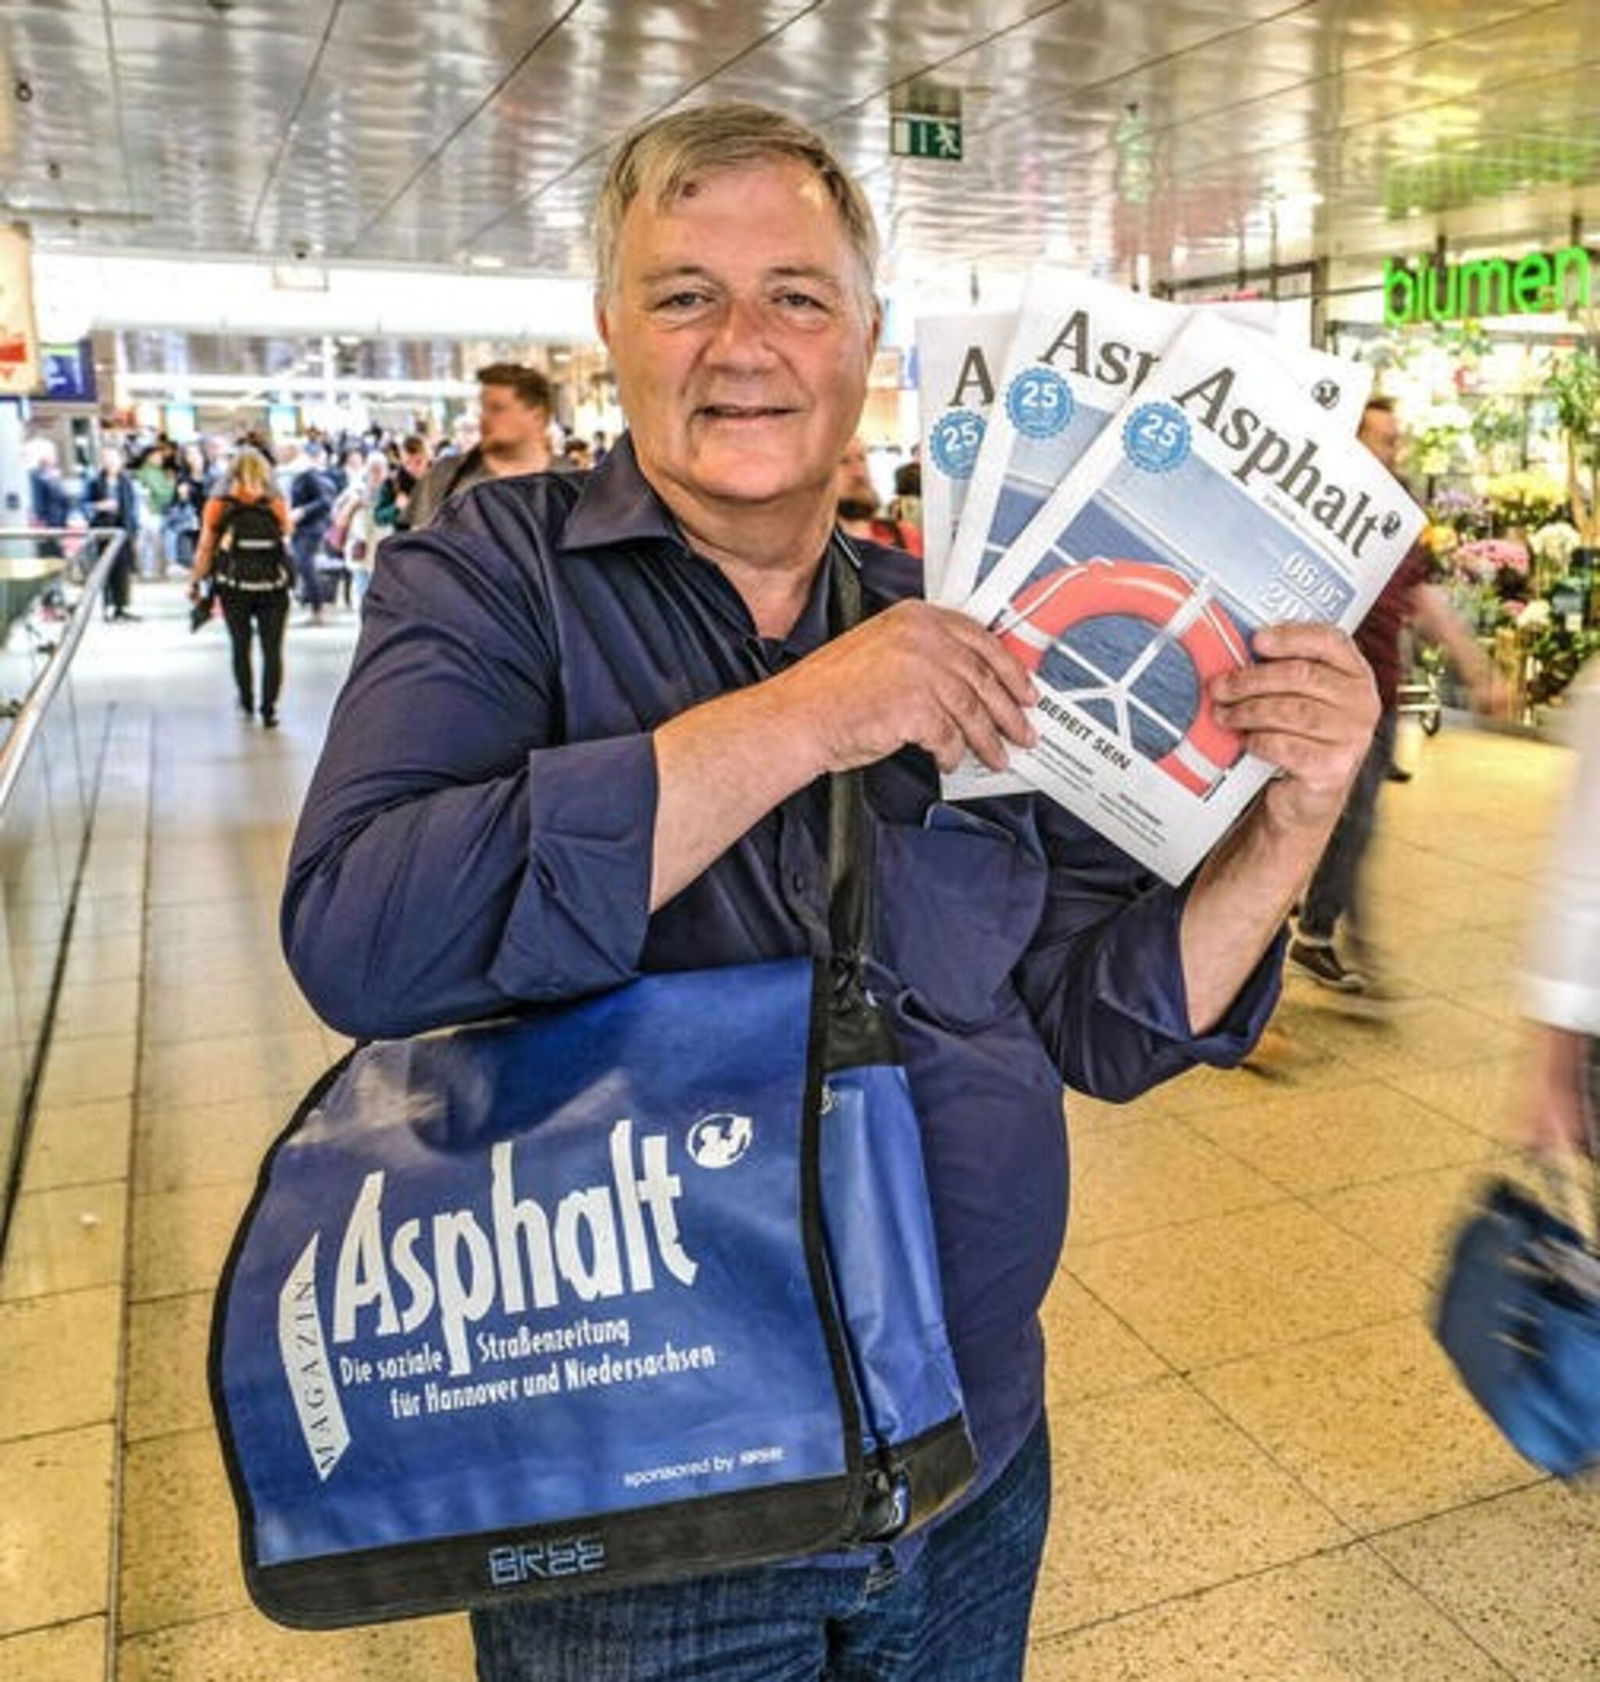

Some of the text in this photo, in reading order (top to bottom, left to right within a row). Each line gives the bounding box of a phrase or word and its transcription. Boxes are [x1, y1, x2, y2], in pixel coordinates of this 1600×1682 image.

[1383, 245, 1591, 328] blumen
[1020, 380, 1059, 409] 25
[1141, 413, 1182, 451] 25
[942, 422, 980, 453] 25
[1172, 366, 1379, 558] Asphalt
[1037, 696, 1094, 742] BEREIT
[1092, 736, 1133, 771] SEIN
[332, 1119, 700, 1377] Asphalt
[294, 1279, 337, 1471] MAGAZIN
[339, 1316, 631, 1387] Die soziale Straßenzeitung
[389, 1343, 716, 1420] für Hannover und Niedersachsen
[624, 1456, 710, 1489] sponsored
[713, 1455, 734, 1474] by
